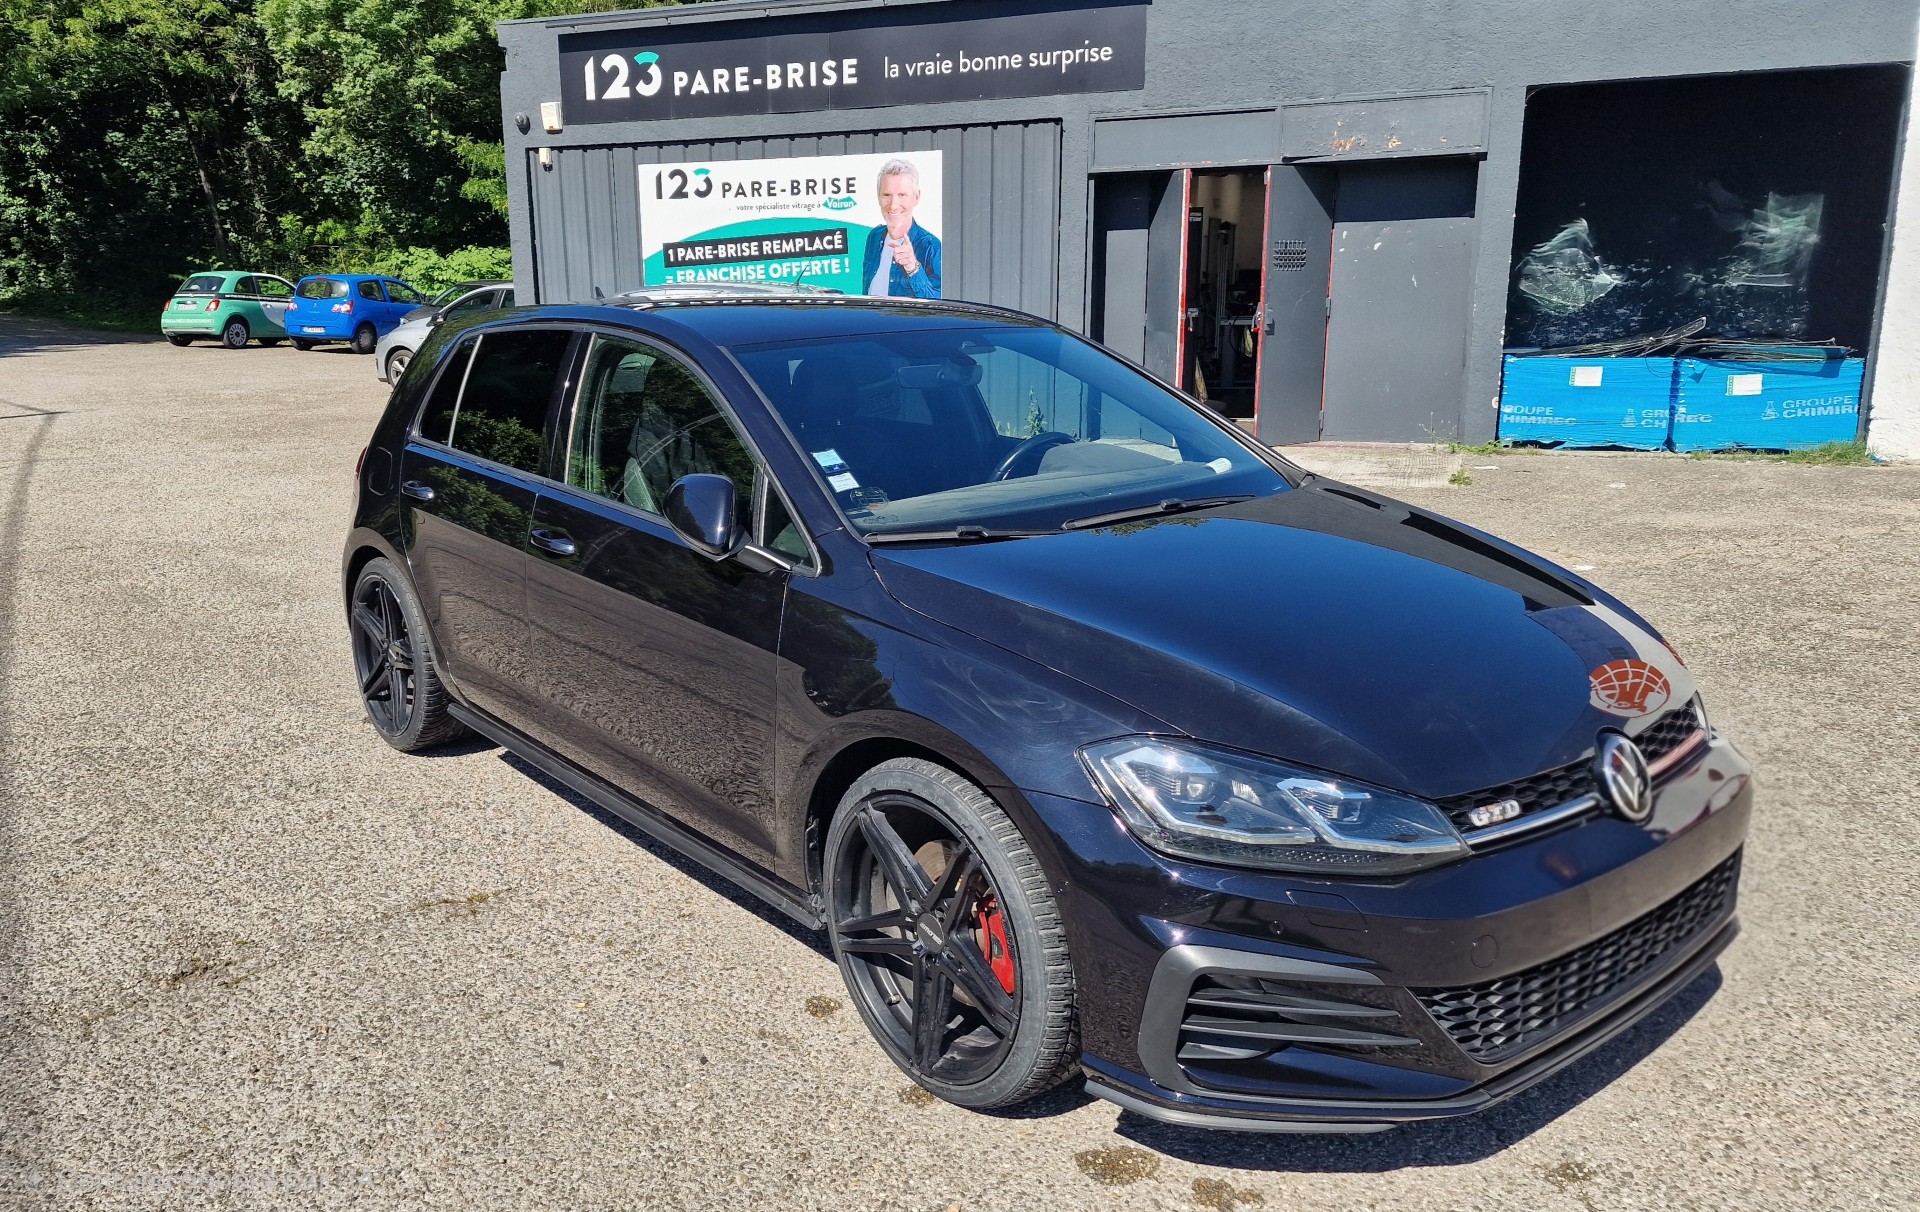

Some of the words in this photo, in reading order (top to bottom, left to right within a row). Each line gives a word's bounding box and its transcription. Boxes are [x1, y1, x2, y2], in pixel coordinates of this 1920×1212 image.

[884, 56, 899, 79] la
[905, 52, 953, 76] vraie
[959, 50, 1023, 73] bonne
[1028, 39, 1113, 74] surprise
[584, 51, 662, 101] 123
[673, 58, 858, 96] PARE-BRISE
[655, 168, 713, 199] 123
[722, 177, 857, 198] PARE-BRISE
[736, 203, 754, 211] votre
[755, 202, 790, 213] spécialiste
[792, 201, 816, 212] vitrage
[826, 199, 854, 209] Voiron
[667, 248, 674, 262] 1
[677, 241, 759, 262] PARE-BRISE
[762, 230, 843, 255] REMPLACÉ
[676, 264, 766, 284] FRANCHISE
[768, 258, 841, 279] OFFERTE
[1782, 395, 1853, 409] GROUPE
[1469, 799, 1520, 827] GTD
